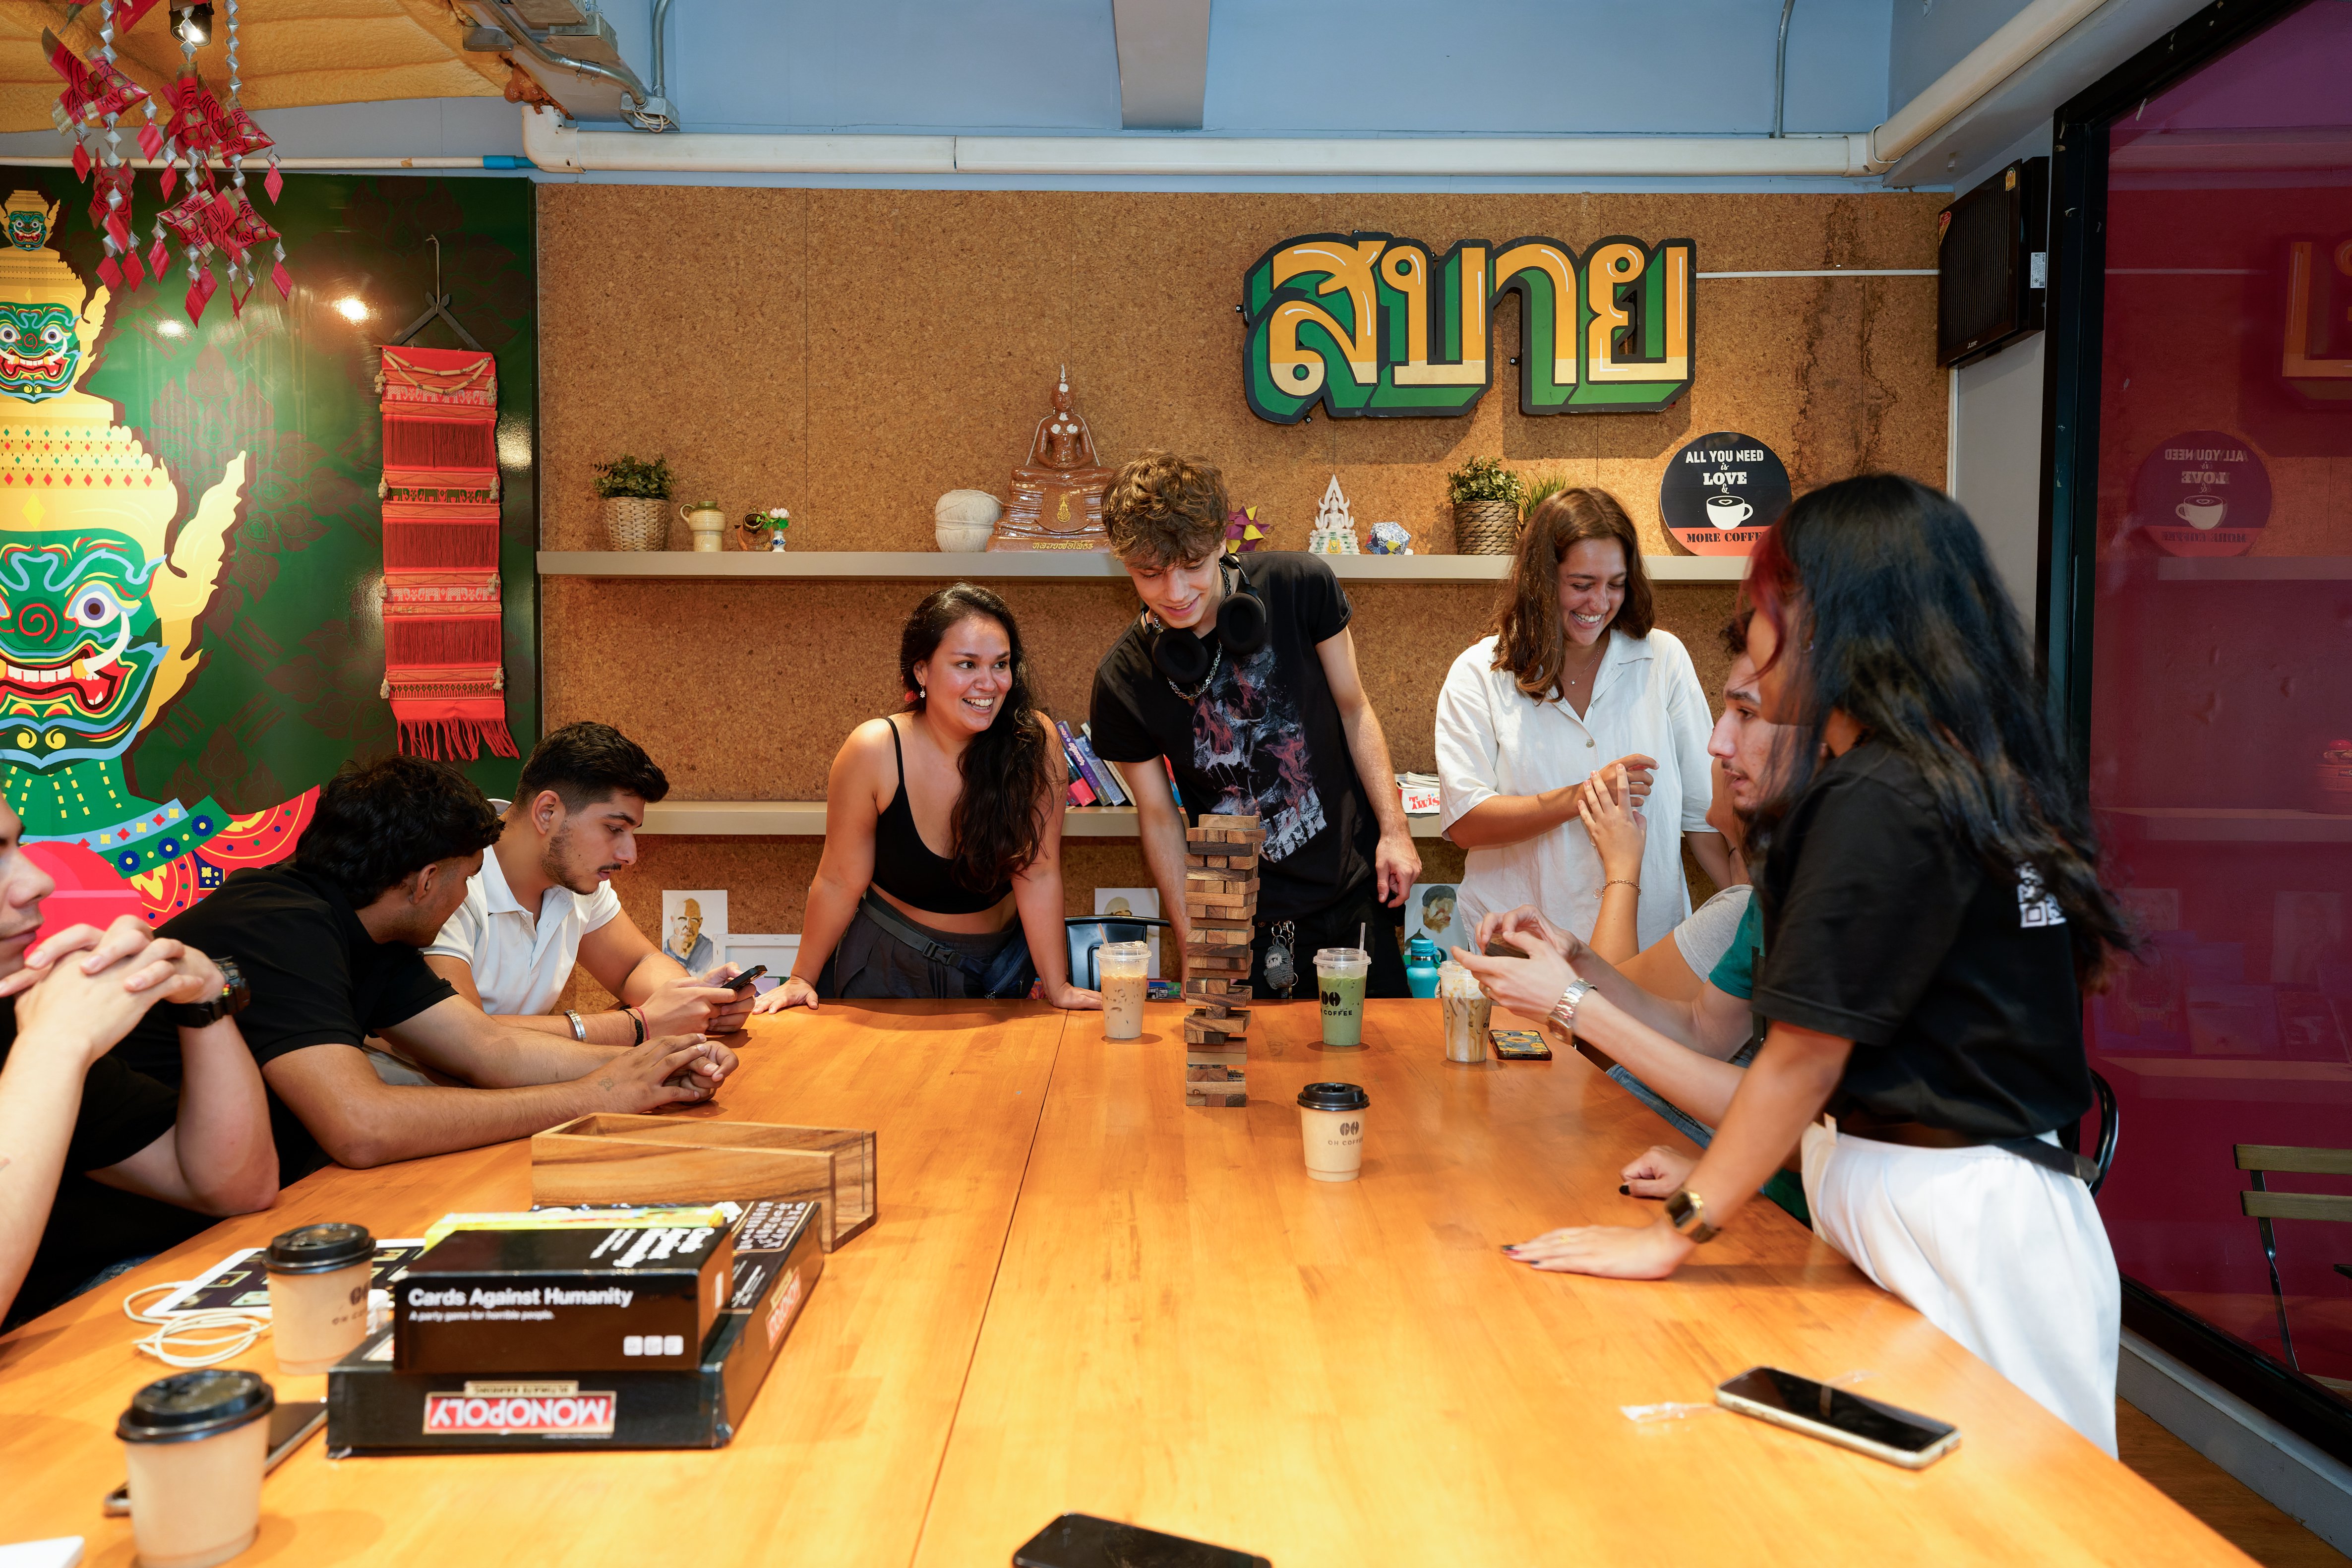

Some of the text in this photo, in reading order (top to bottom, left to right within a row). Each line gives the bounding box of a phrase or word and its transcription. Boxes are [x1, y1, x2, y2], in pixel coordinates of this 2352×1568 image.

[1265, 238, 1690, 402] สบาย
[1686, 449, 1764, 463] ALL YOU NEED
[1720, 462, 1729, 471] is
[1703, 472, 1747, 485] LOVE
[1721, 483, 1730, 494] &
[1687, 533, 1721, 543] MORE
[1409, 794, 1440, 810] Twis
[408, 1287, 633, 1309] Cards Against Humanity
[409, 1311, 418, 1321] A
[418, 1311, 443, 1322] party
[444, 1311, 471, 1322] game
[471, 1310, 484, 1321] for
[485, 1310, 521, 1320] horrible
[430, 1398, 607, 1427] MONOPOLY
